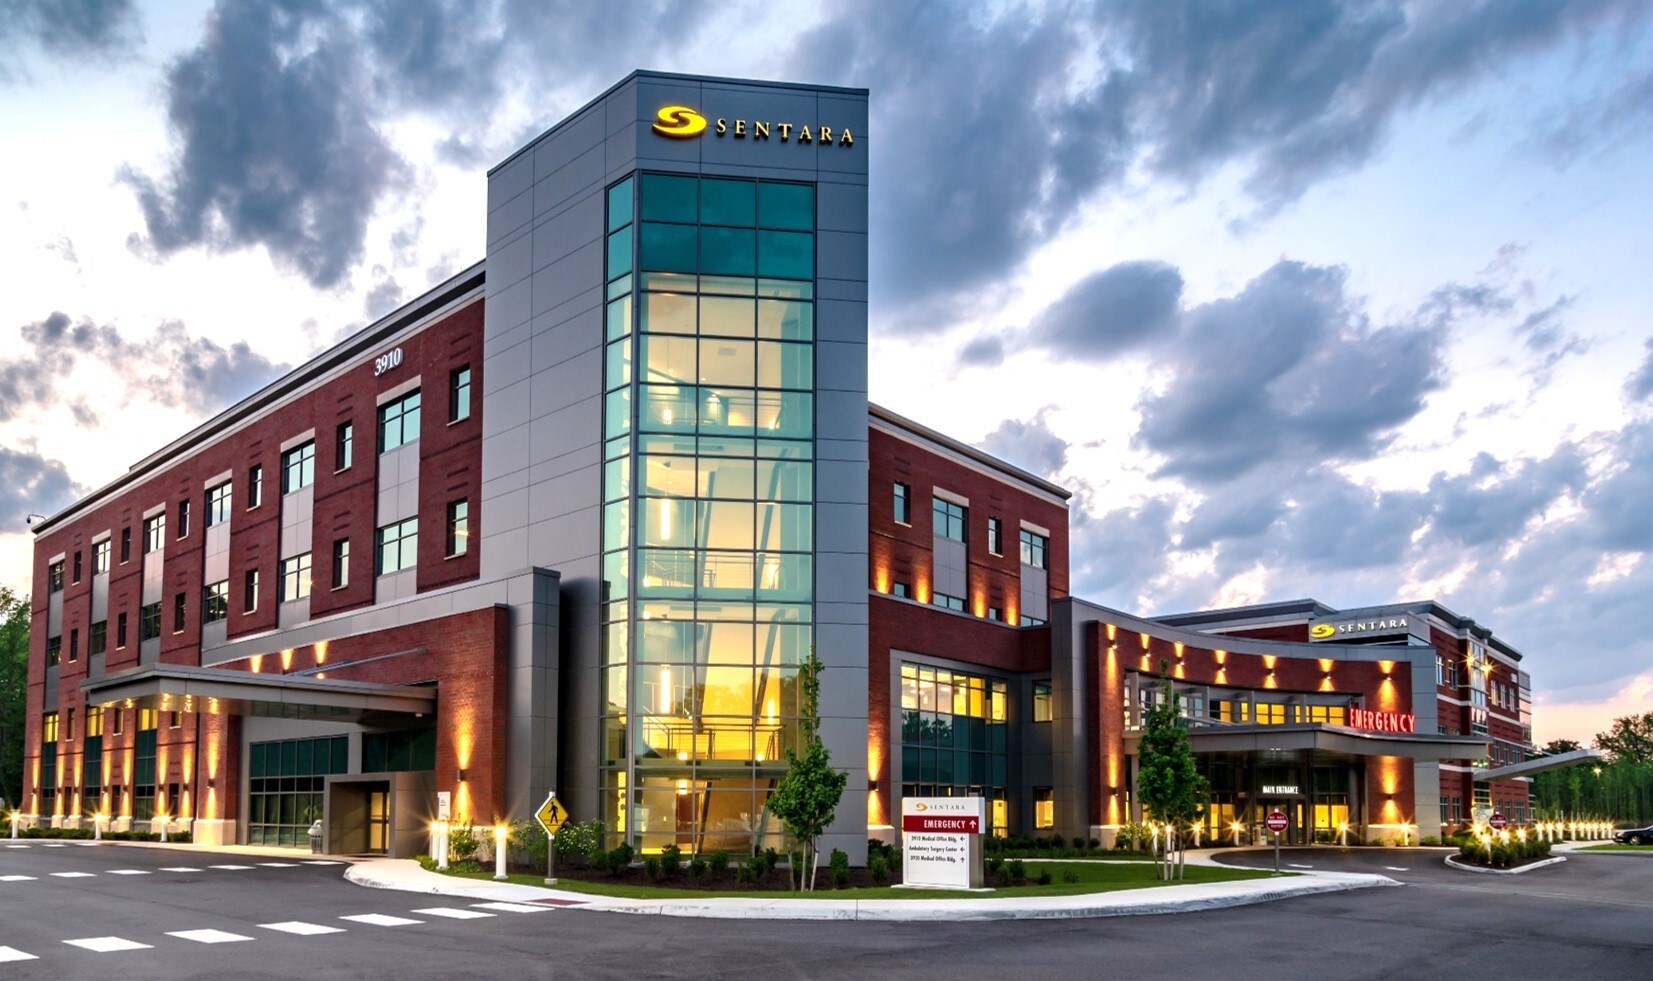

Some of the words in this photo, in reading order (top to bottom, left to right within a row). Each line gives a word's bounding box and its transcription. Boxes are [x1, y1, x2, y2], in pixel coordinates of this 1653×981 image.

[716, 117, 854, 147] SENTARA
[374, 347, 403, 377] 3910
[1339, 618, 1408, 634] SENTARA
[1349, 707, 1416, 733] EMERGENCY
[923, 819, 966, 829] EMERGENCY
